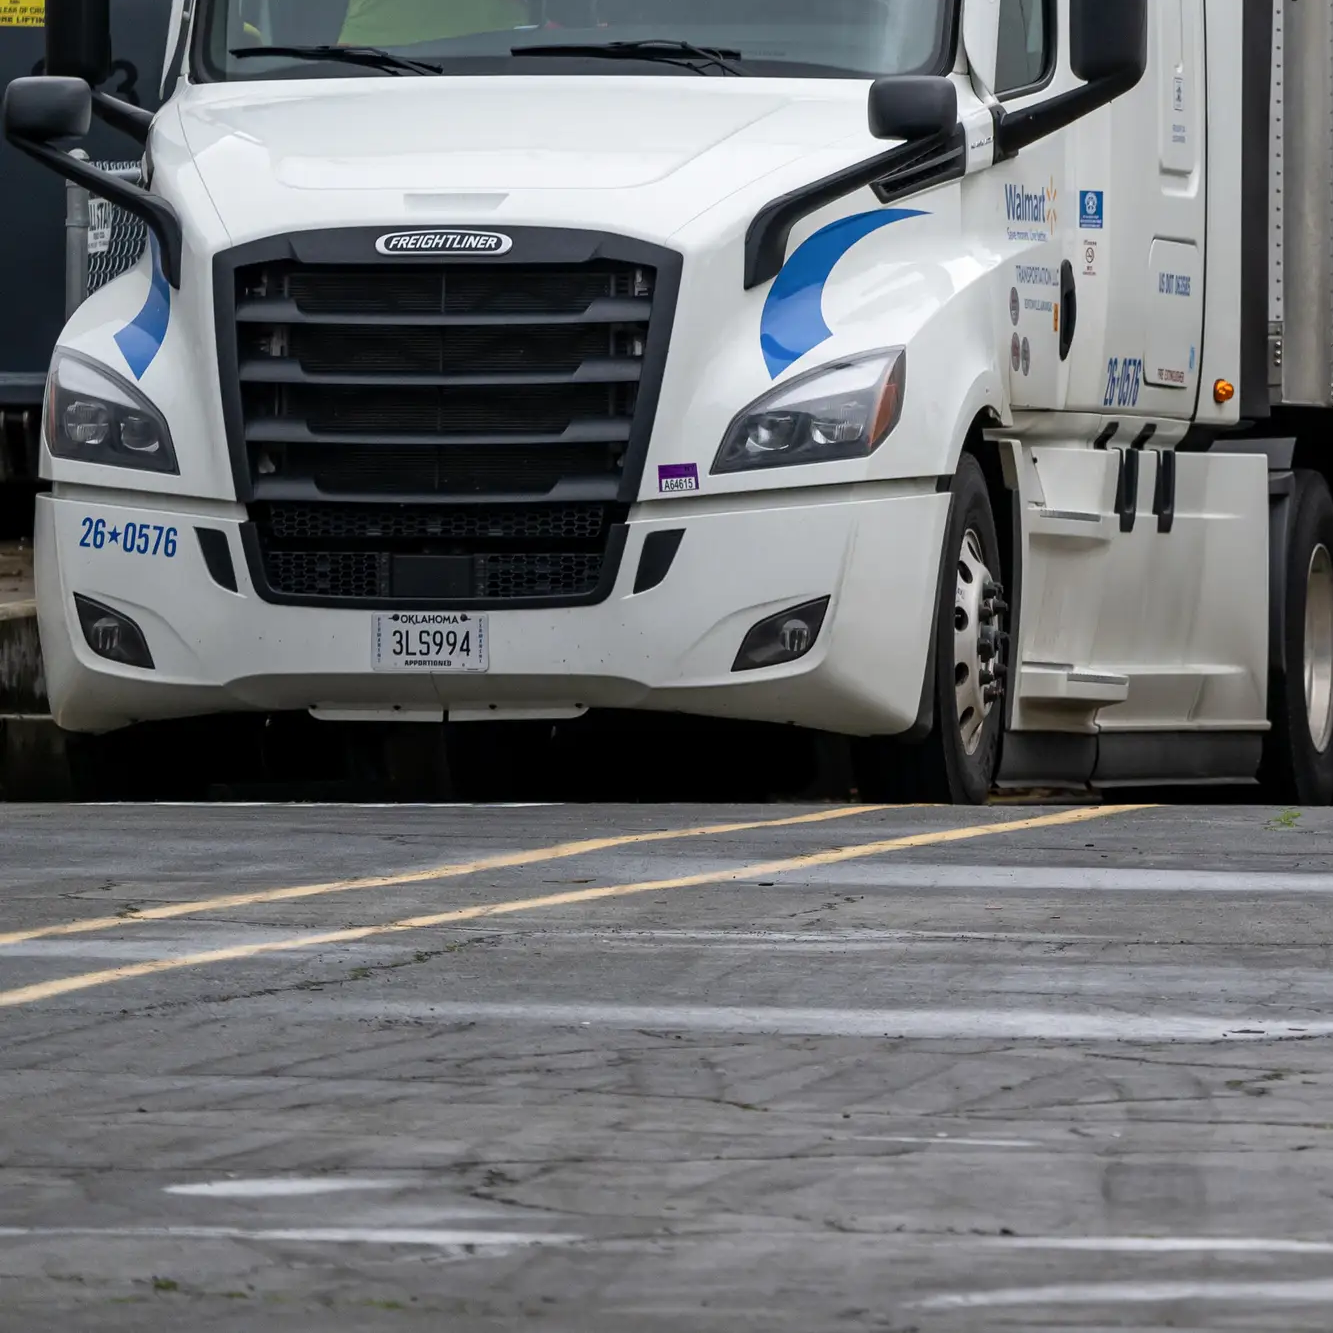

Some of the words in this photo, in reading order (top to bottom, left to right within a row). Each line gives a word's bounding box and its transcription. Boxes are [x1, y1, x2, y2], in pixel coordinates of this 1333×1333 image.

[1004, 183, 1046, 223] Walmart
[389, 234, 498, 249] FREIGHTLINER
[664, 478, 694, 491] A64615
[400, 614, 459, 625] OKLAHOMA
[392, 630, 471, 657] 3LS994
[404, 659, 452, 667] APPORTIONED
